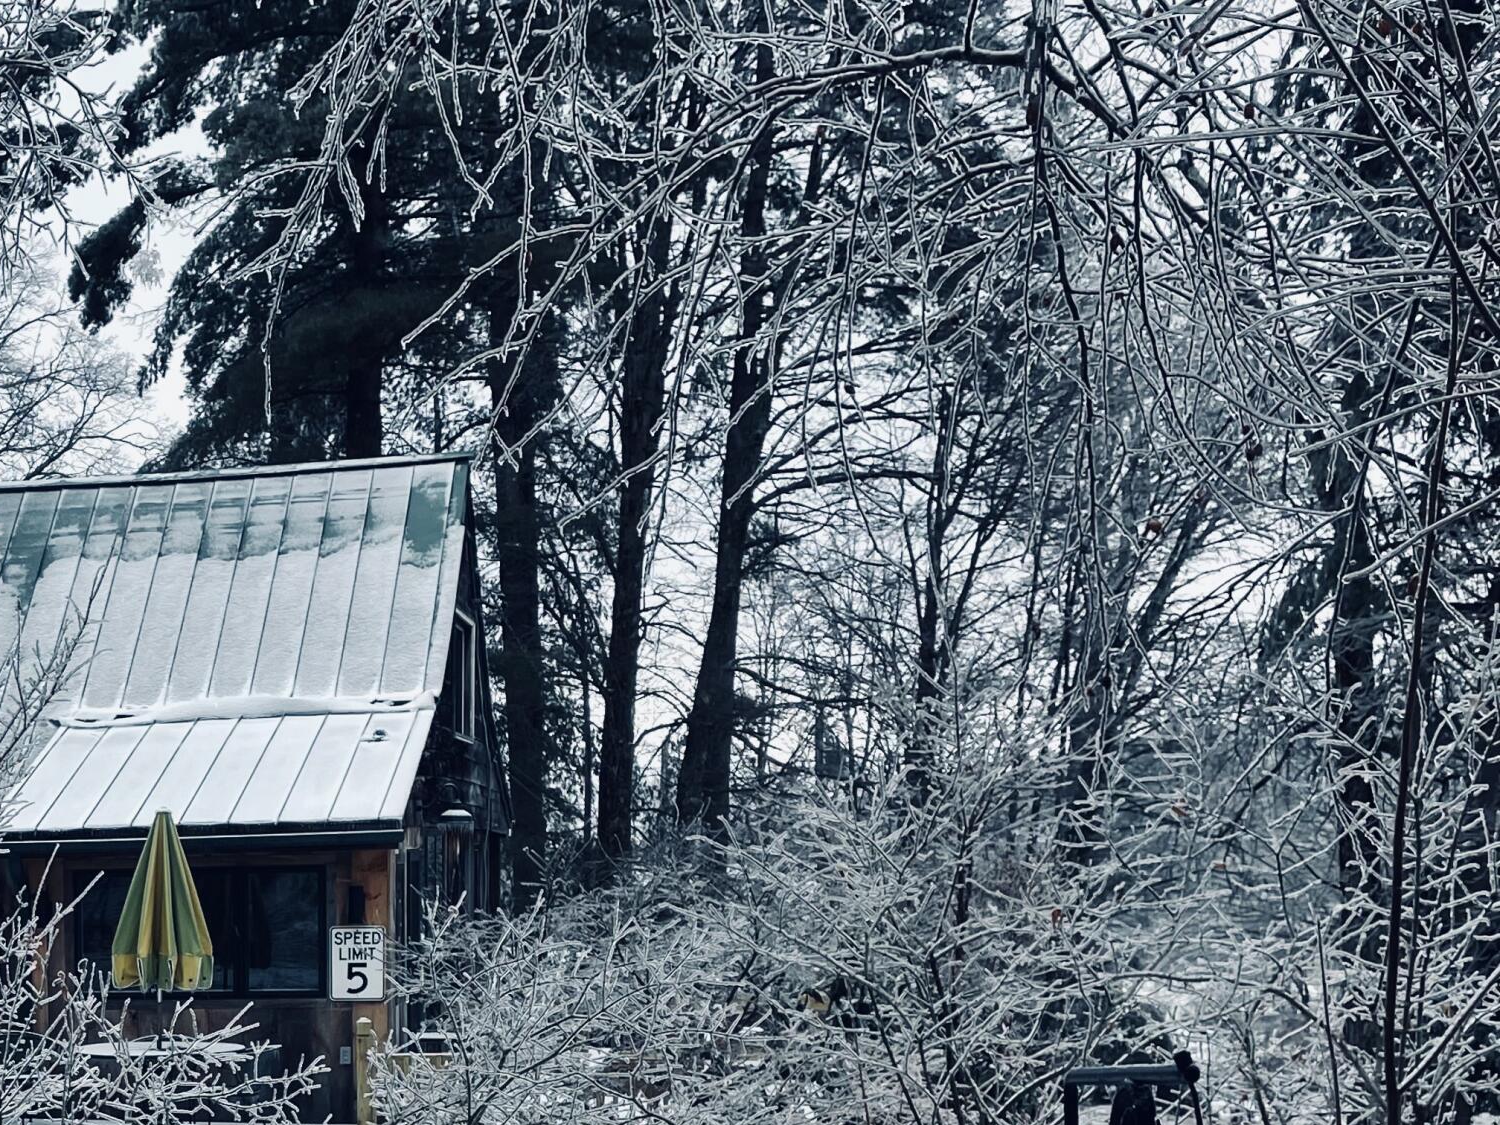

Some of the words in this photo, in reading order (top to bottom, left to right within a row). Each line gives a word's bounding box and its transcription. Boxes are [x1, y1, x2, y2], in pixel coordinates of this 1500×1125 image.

[334, 931, 381, 945] SPEED
[339, 947, 376, 960] LIMIT
[346, 962, 368, 994] 5
